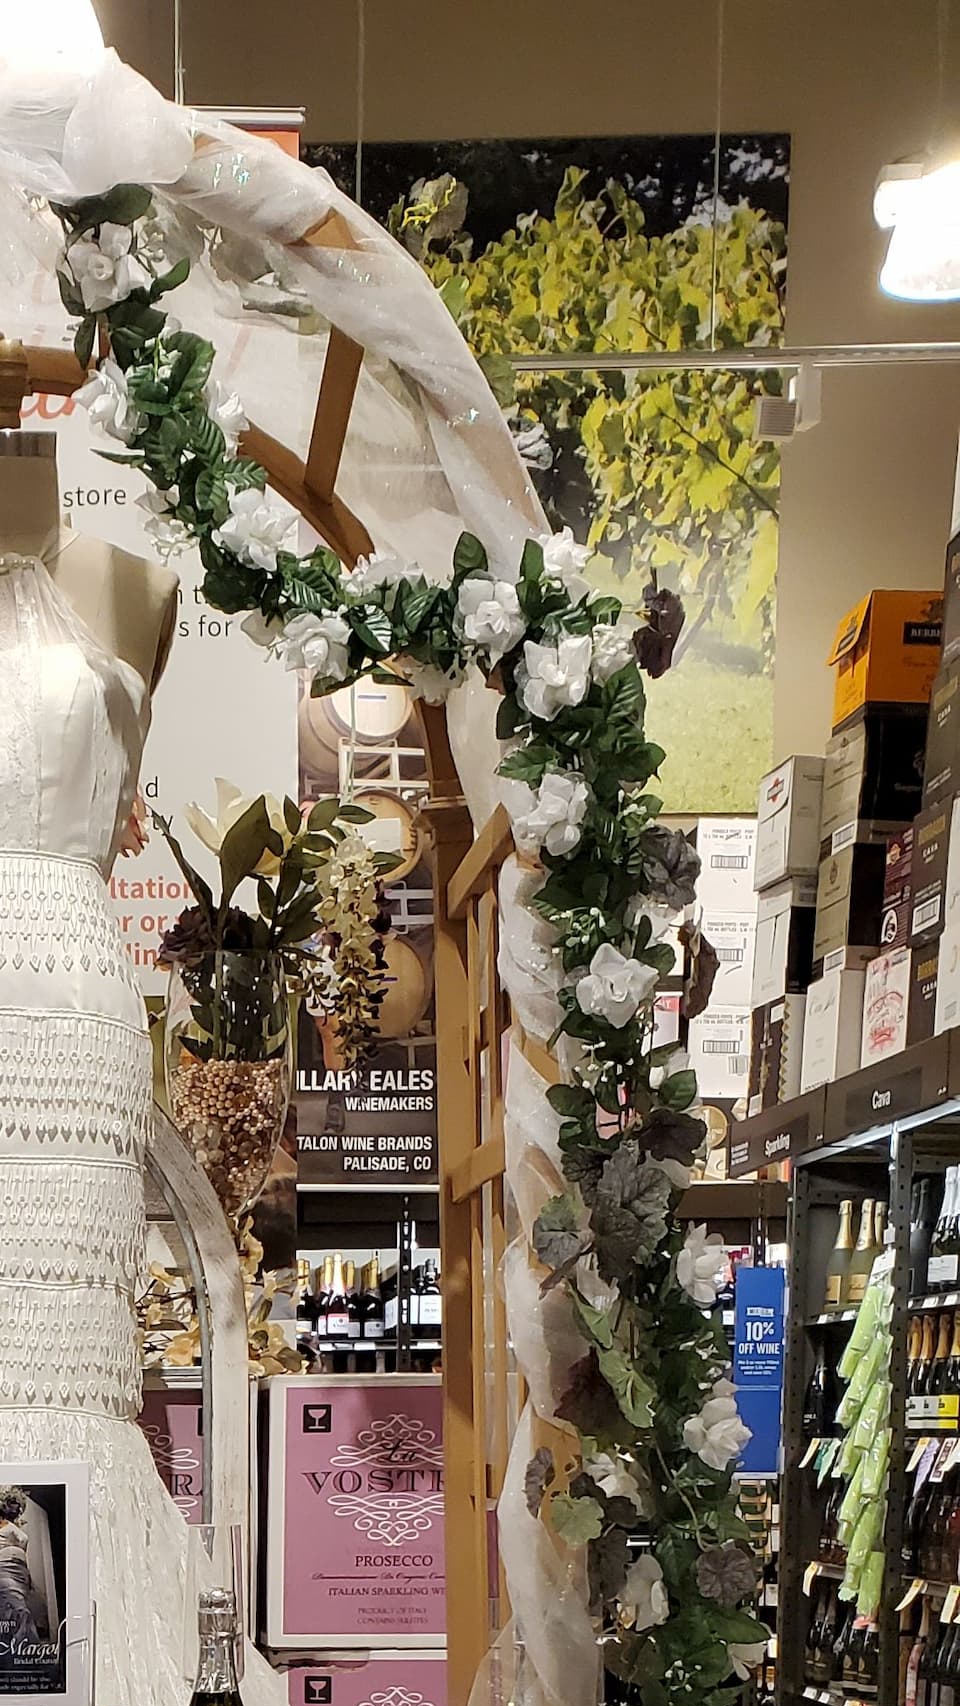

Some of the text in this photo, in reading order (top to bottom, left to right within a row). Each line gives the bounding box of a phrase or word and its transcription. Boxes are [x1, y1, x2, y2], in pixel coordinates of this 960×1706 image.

[63, 488, 127, 508] store
[198, 616, 233, 637] for
[110, 875, 189, 899] ltatio
[370, 1070, 434, 1091] EALES
[872, 1090, 891, 1111] Cava
[296, 1136, 433, 1151] TALON WINE BRANDS
[343, 1156, 432, 1172] PALISADE, CO
[745, 1321, 775, 1341] 10%
[738, 1342, 780, 1355] OFF WINE
[376, 1440, 417, 1463] La
[301, 1470, 445, 1494] VOSTR
[355, 1555, 433, 1567] PROSECCO
[328, 1587, 428, 1596] ITALIAN SPARKLING
